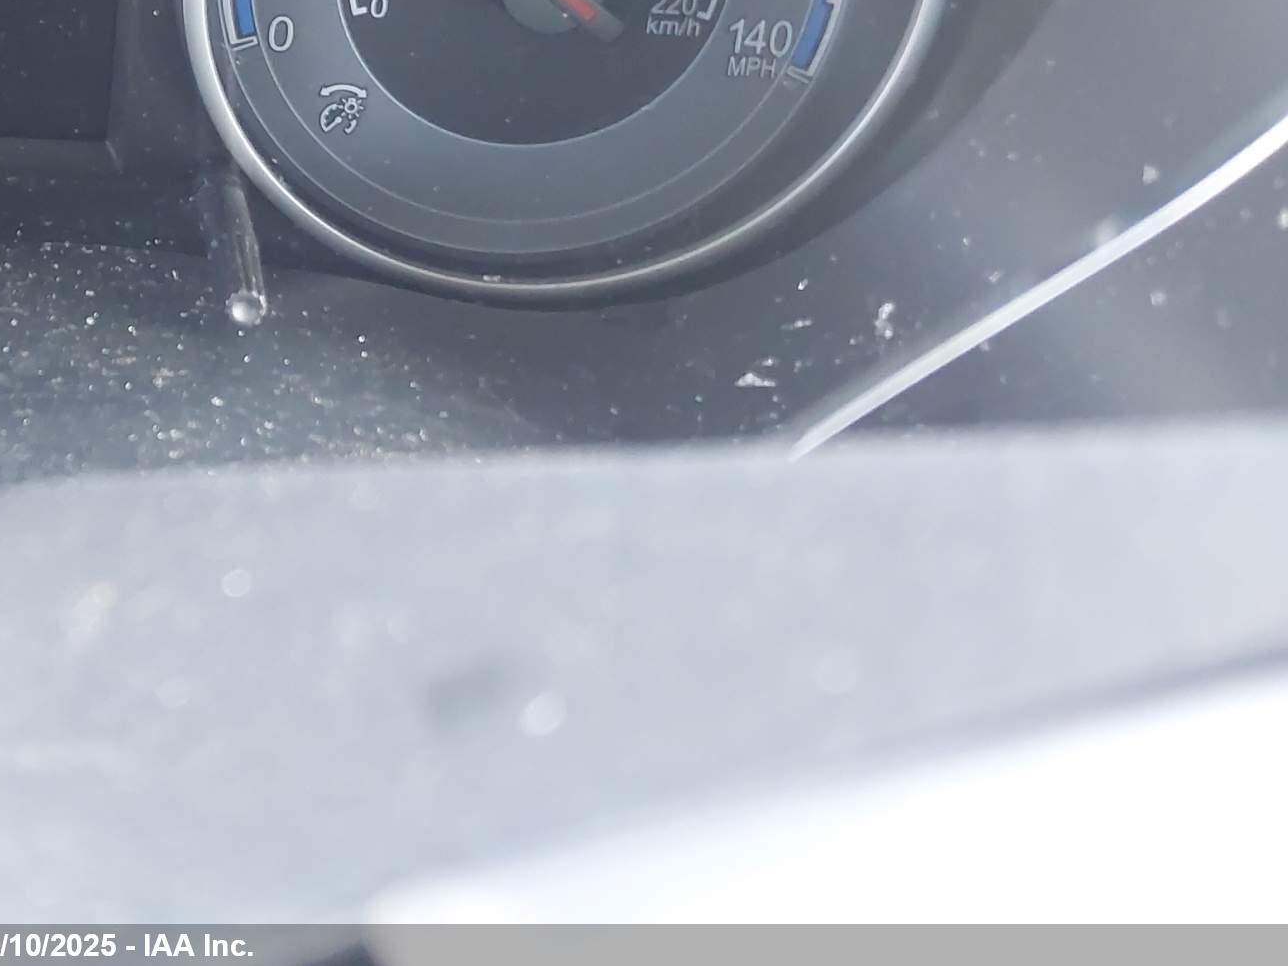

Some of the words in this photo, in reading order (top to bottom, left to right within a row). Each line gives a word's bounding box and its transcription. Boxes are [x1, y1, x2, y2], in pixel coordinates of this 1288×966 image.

[268, 16, 294, 52] 0
[646, 14, 700, 37] km/h
[729, 19, 792, 57] 140
[727, 56, 777, 78] MPH
